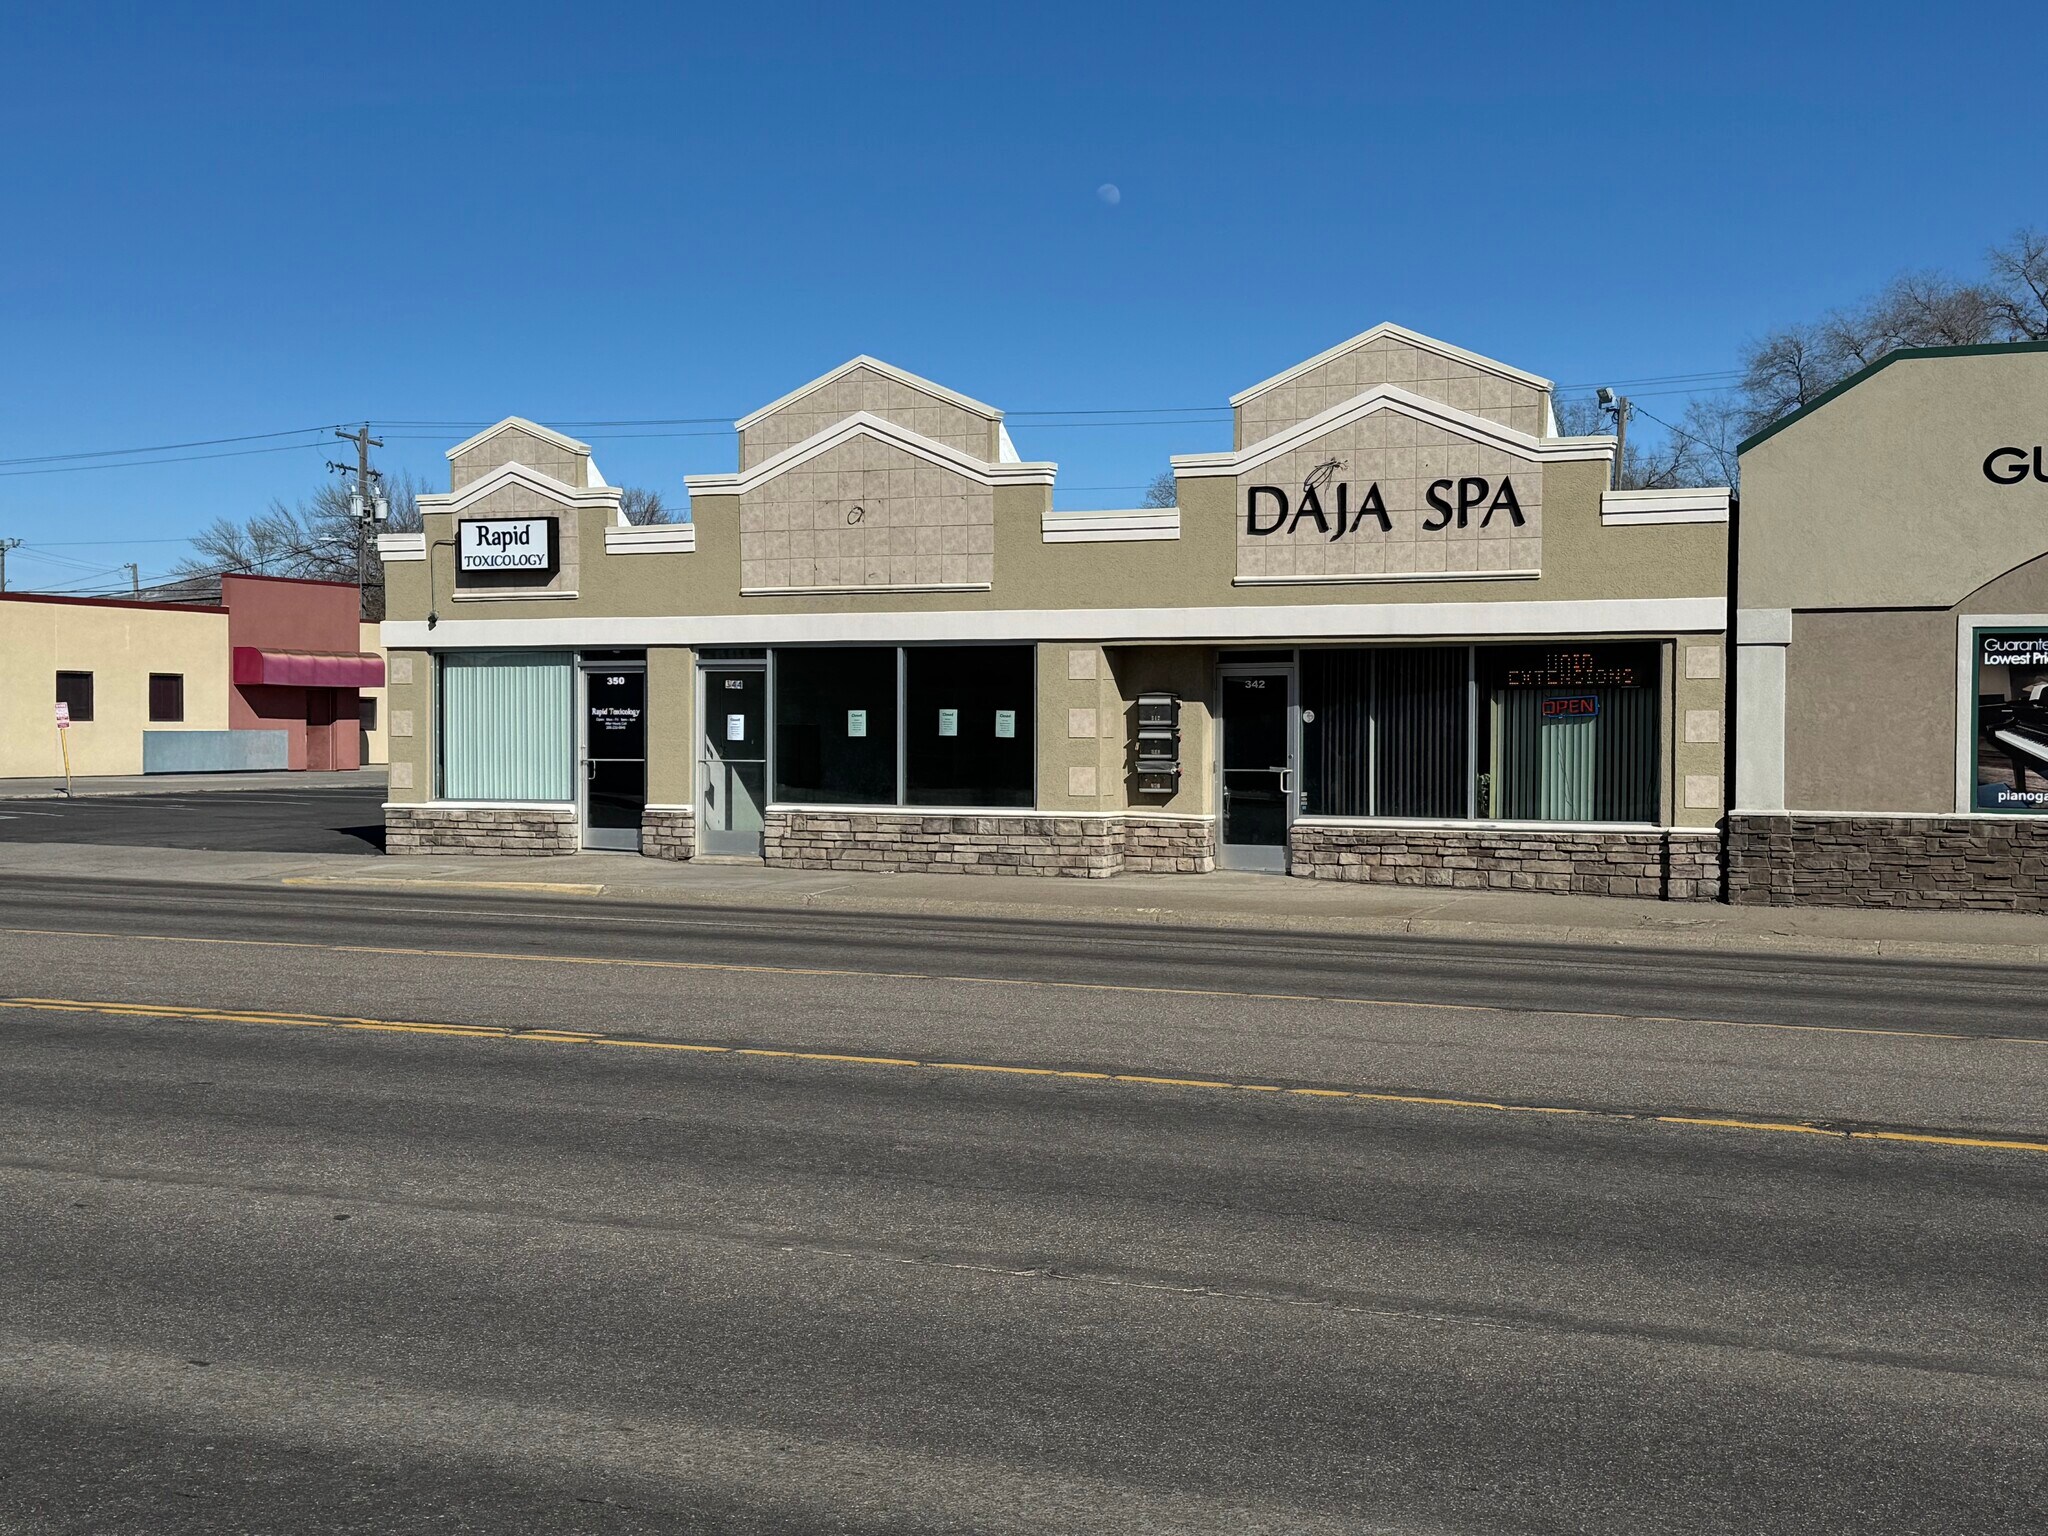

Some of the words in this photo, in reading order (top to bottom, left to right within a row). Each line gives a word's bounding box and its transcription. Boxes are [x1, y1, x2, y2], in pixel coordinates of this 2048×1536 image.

[1246, 481, 1393, 542] DAJA
[1422, 475, 1526, 532] SPA
[476, 524, 531, 553] Rapid
[464, 554, 545, 567] TOXICOLOGY
[1984, 652, 2030, 665] Lowest
[606, 676, 625, 685] 350
[1245, 680, 1265, 689] 342
[591, 707, 608, 717] Rapid
[609, 707, 640, 717] Toxicology
[1542, 700, 1594, 715] OPEN
